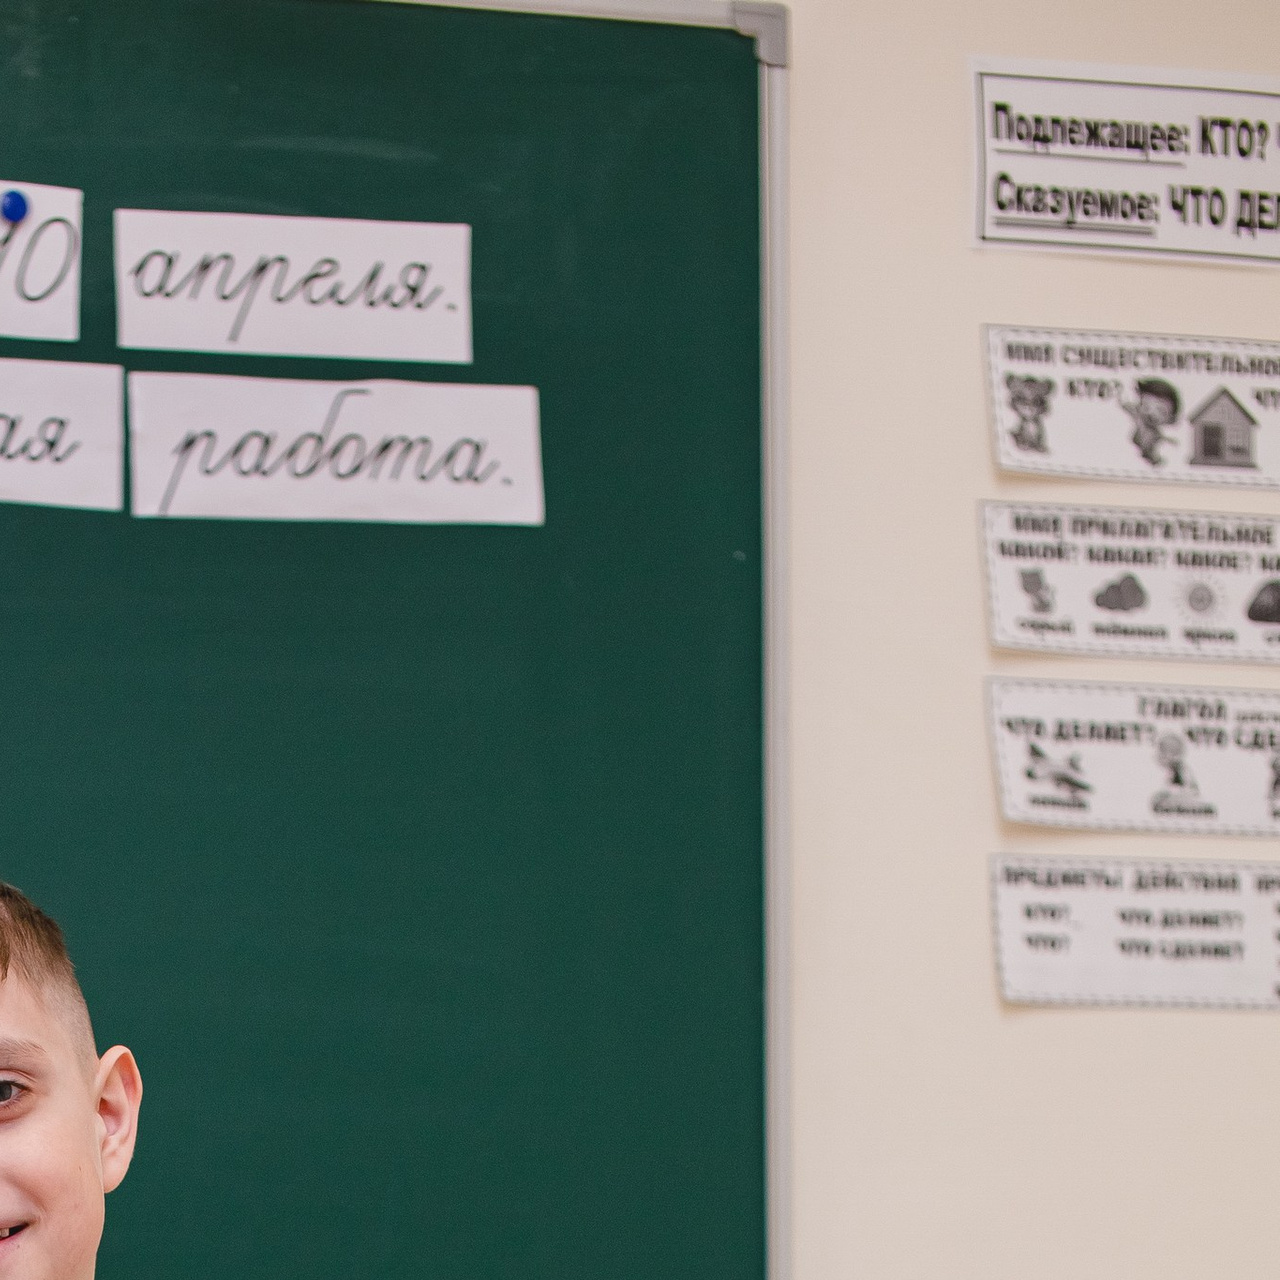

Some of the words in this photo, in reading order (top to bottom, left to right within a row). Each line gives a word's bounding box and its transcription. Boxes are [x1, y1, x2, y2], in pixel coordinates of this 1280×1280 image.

[994, 102, 1190, 160] Подлежащее:
[1200, 116, 1269, 159] КТО?
[994, 172, 1160, 224] Сказуемое:
[1170, 185, 1227, 226] ЧТО
[131, 246, 459, 343] апреля.
[158, 389, 514, 516] работа.
